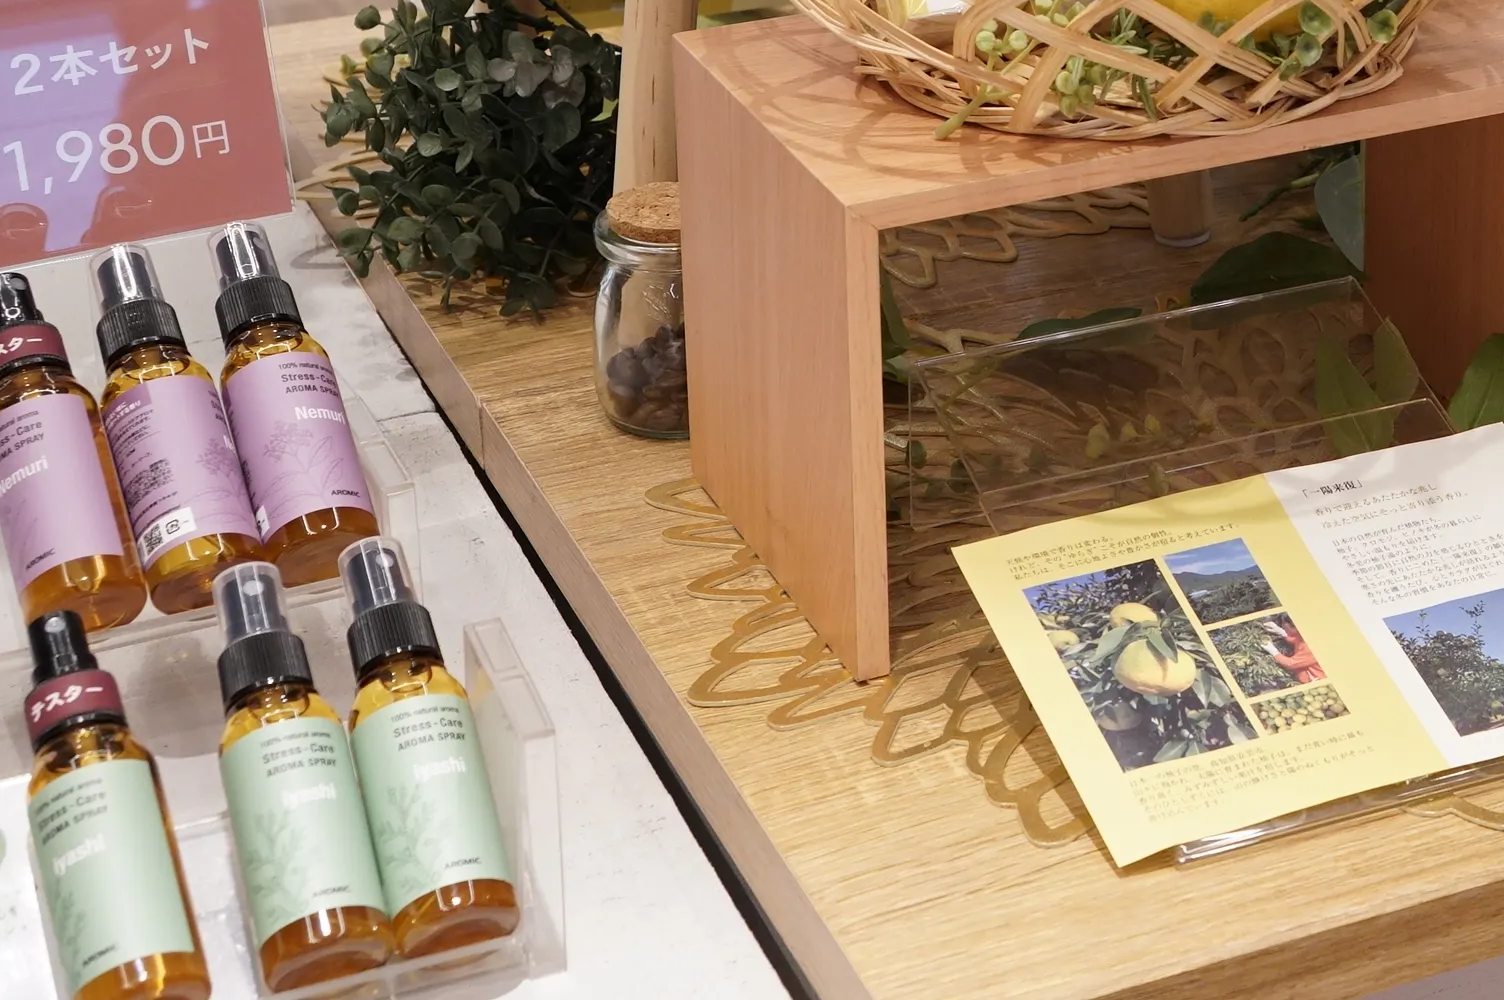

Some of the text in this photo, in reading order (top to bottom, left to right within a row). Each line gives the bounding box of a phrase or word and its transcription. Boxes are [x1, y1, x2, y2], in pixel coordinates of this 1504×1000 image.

[10, 28, 209, 96] 2本セット
[4, 114, 230, 195] 1,980円
[279, 362, 297, 370] 100%
[285, 384, 318, 394] AROMA
[294, 405, 346, 425] Nemuri
[14, 432, 45, 451] SPRAY
[331, 489, 361, 498] AROMIC
[1302, 480, 1364, 498] 「一陽来復」
[26, 547, 56, 571] AROMIC
[31, 684, 103, 723] テスター
[391, 710, 411, 723] 100%
[413, 705, 438, 716] natural
[398, 731, 466, 752] AROMA SPRAY
[266, 758, 336, 778] AROMA SPRAY
[412, 756, 467, 783] iyashi
[42, 820, 70, 846] AROMA
[52, 832, 106, 877] iyashi
[445, 857, 482, 869] AROMIC
